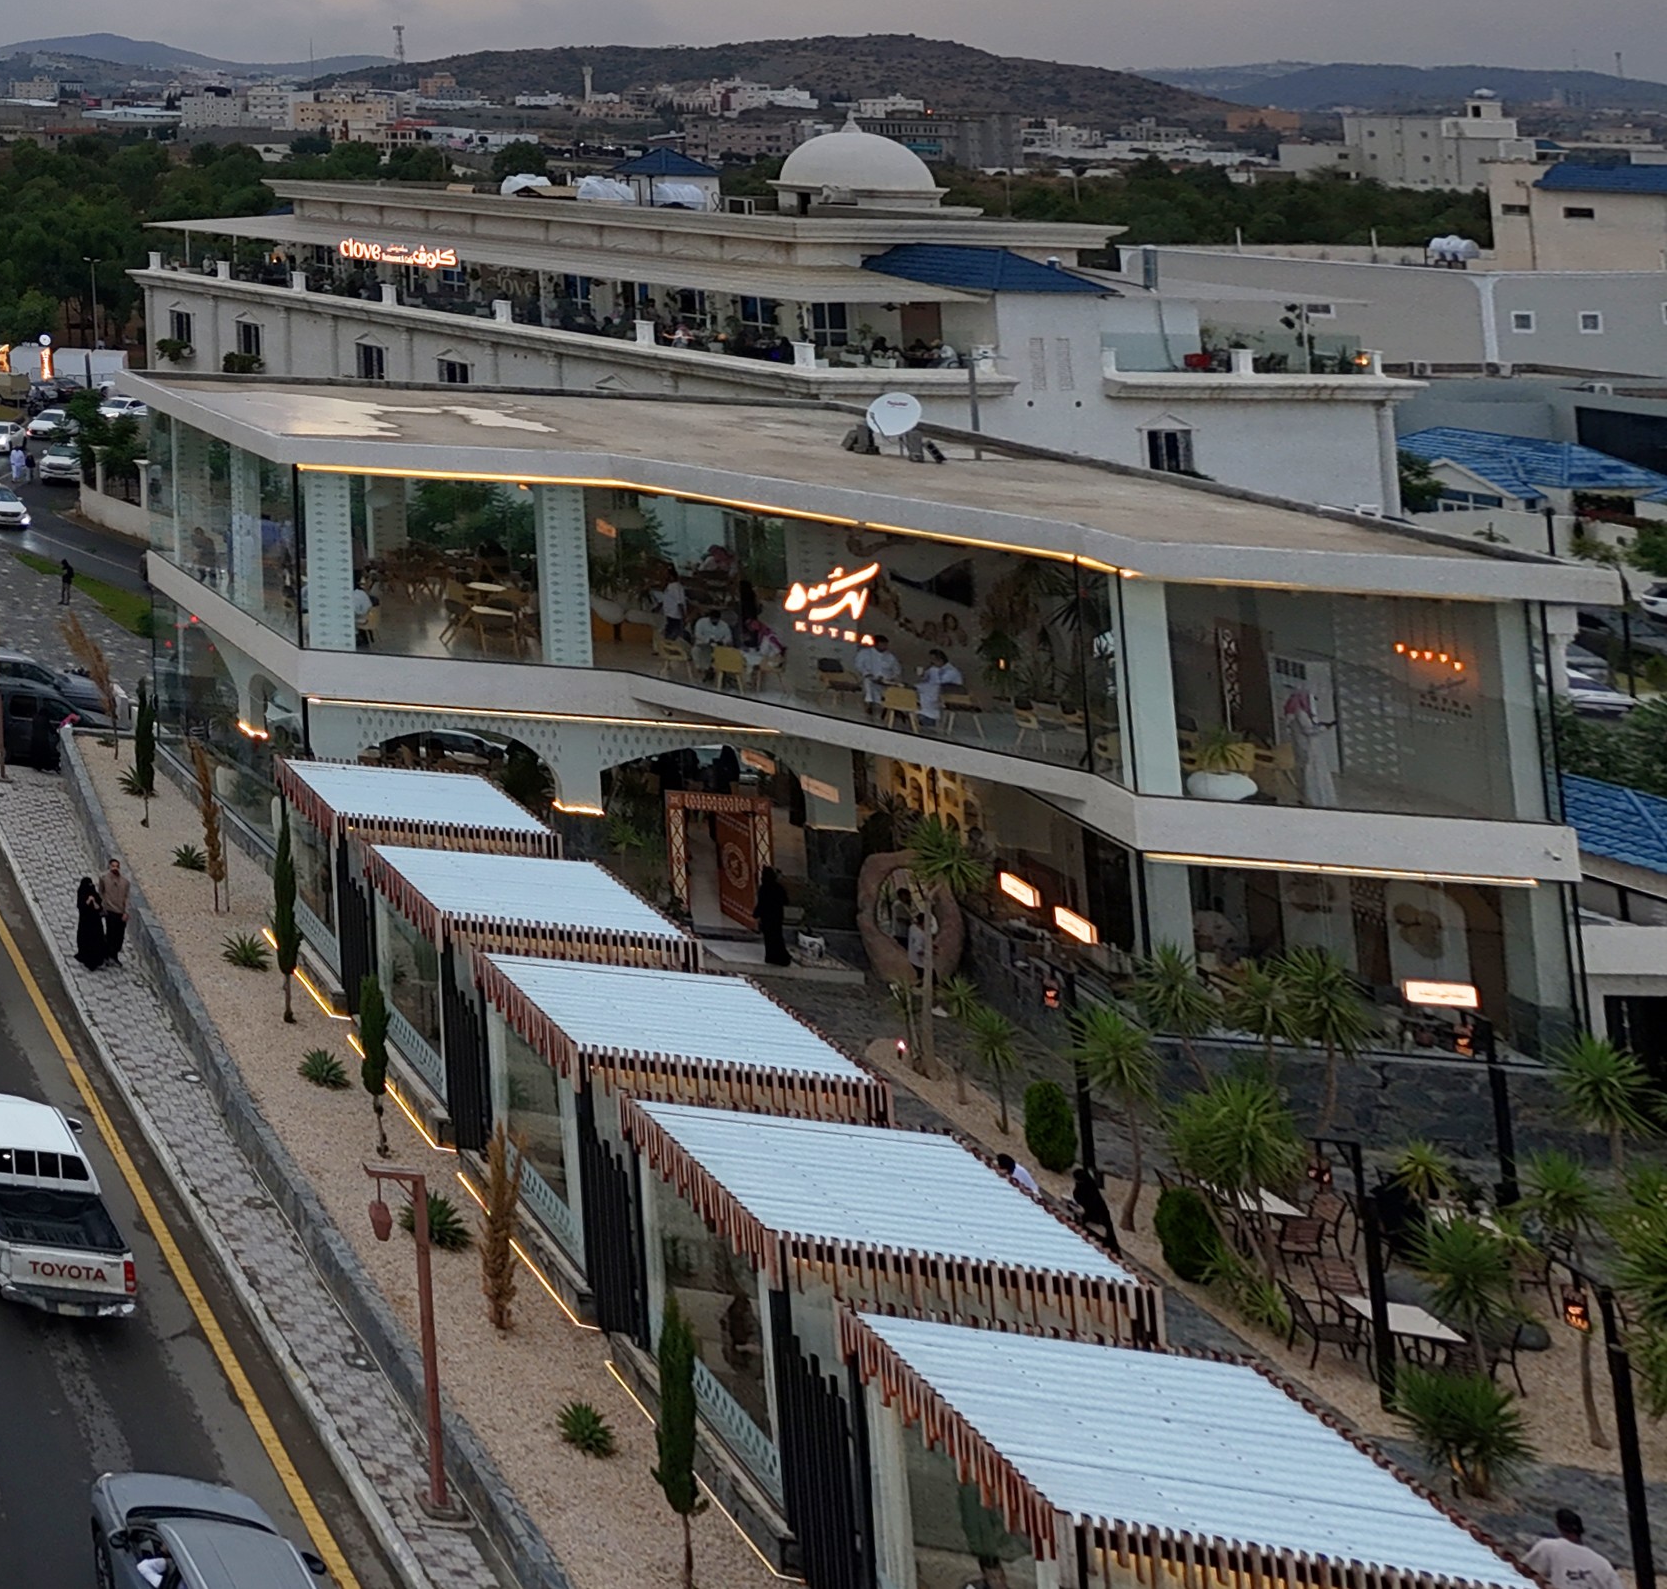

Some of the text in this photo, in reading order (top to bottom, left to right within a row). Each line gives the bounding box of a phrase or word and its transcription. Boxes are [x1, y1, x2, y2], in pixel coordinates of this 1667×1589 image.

[339, 238, 381, 261] clove
[794, 620, 875, 646] KUTRA
[28, 1260, 108, 1283] TOYOTA
